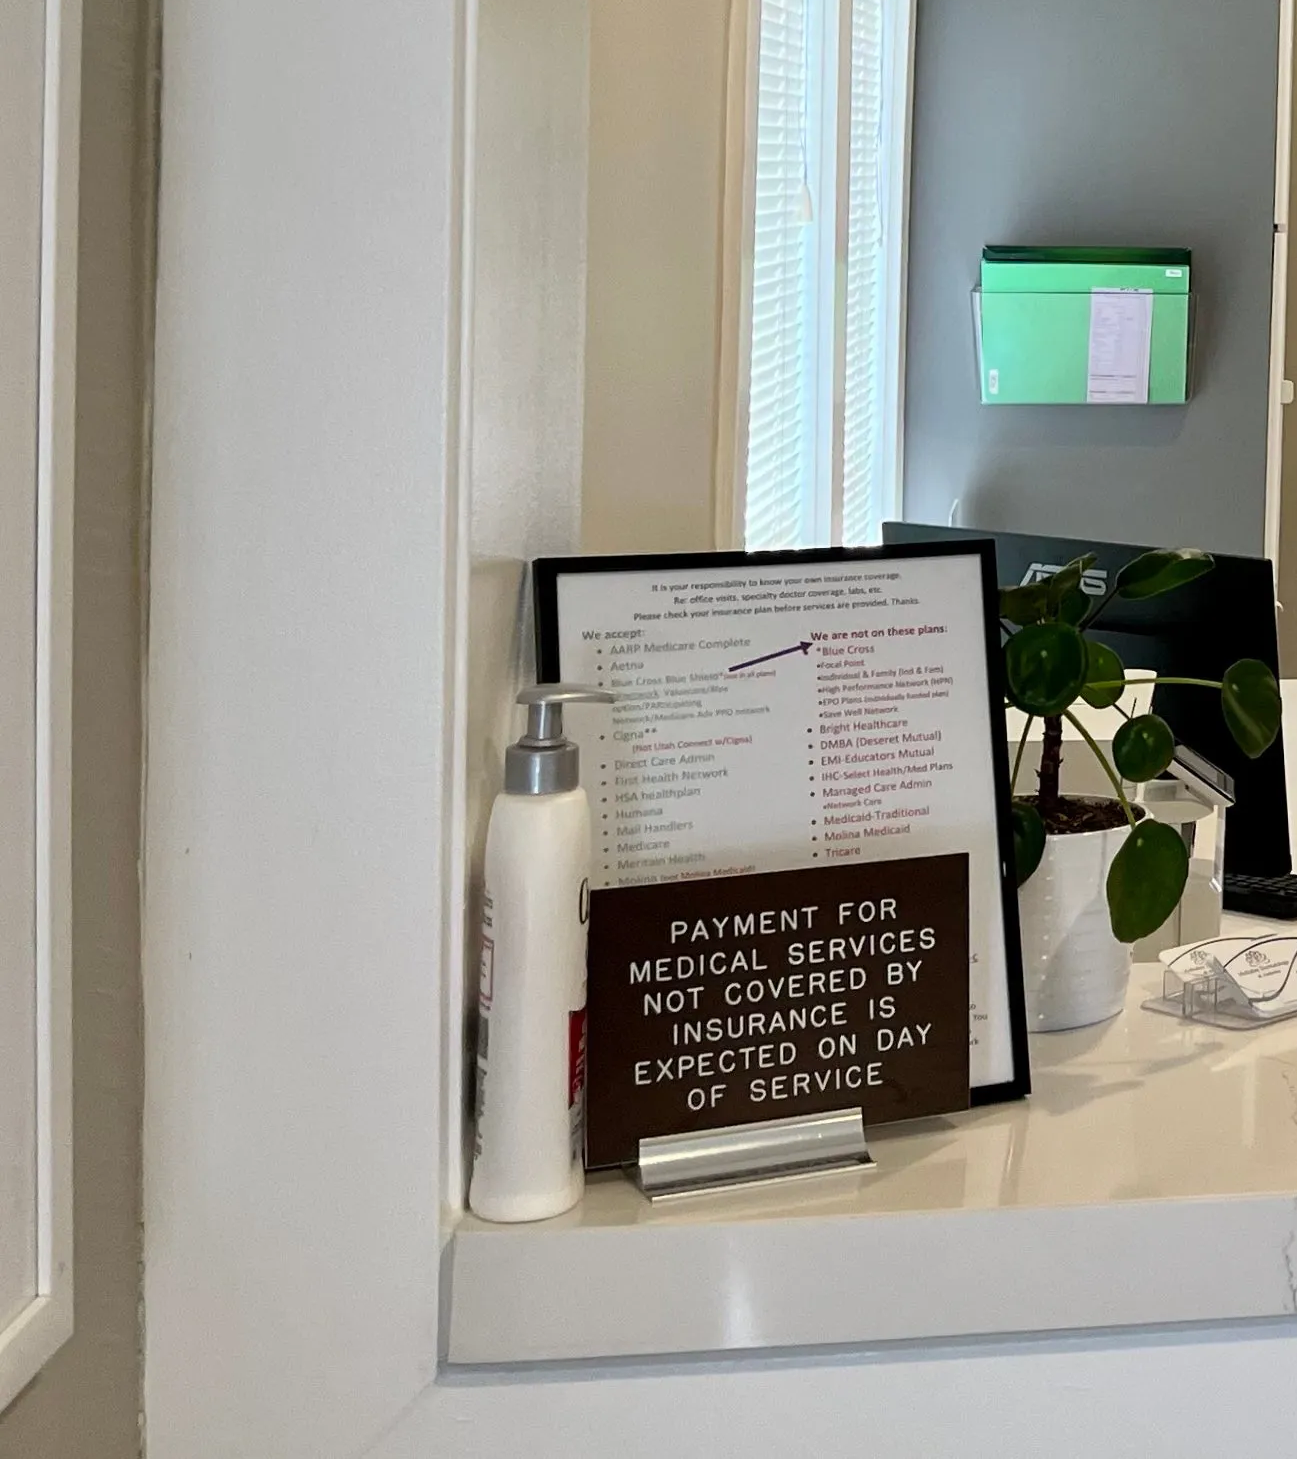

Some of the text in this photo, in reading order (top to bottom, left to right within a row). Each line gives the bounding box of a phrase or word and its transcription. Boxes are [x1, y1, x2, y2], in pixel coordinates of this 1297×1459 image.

[669, 584, 688, 593] your
[691, 579, 746, 591] responsibility
[749, 579, 758, 587] to
[759, 577, 782, 586] know
[784, 577, 802, 586] your
[804, 576, 822, 584] own
[824, 574, 862, 582] insurance
[690, 594, 713, 604] office
[742, 591, 776, 602] specialty
[779, 590, 806, 599] doctor
[633, 612, 661, 621] Please
[663, 610, 688, 619] check
[690, 610, 710, 619] your
[712, 606, 752, 616] insurance
[754, 605, 772, 615] plan
[774, 603, 801, 613] before
[803, 602, 835, 611] services
[582, 631, 601, 640] We
[811, 632, 829, 641] We
[831, 632, 848, 640] are
[851, 630, 869, 639] not
[887, 626, 915, 636] these
[917, 625, 948, 637] plans:
[610, 638, 751, 655] AARP Medicare Complete
[847, 645, 875, 655] Cross
[610, 661, 644, 672] Aetna
[871, 669, 897, 679] Family
[636, 676, 663, 686] Cross
[665, 674, 686, 684] Blue
[842, 681, 893, 692] Performance
[895, 678, 929, 689] Network
[864, 705, 898, 716] Network
[819, 719, 908, 736] Bright Healthcare
[820, 739, 853, 750] DMBA
[898, 747, 934, 759] Mutual
[614, 753, 715, 771] Direct Care Admin
[930, 762, 953, 772] Plans
[615, 767, 729, 786] First Health Network
[615, 787, 701, 803] HSA healthplan
[822, 779, 932, 798] Managed Care Admin
[615, 807, 663, 820] Humana
[616, 820, 694, 836] Mail Handlers
[824, 824, 910, 841] Molina Medicaid
[617, 840, 670, 853] Medicare
[826, 846, 861, 858] Tricare
[669, 852, 705, 865] Health
[671, 898, 897, 944] PAYMENT FOR
[629, 927, 936, 986] MEDICAL SERVICES
[644, 960, 922, 1016] NOT COVERED BY
[672, 996, 896, 1045] INSURANCE IS
[634, 1023, 932, 1086] EXPECTED ON DAY
[687, 1062, 883, 1111] OF SERVICE
